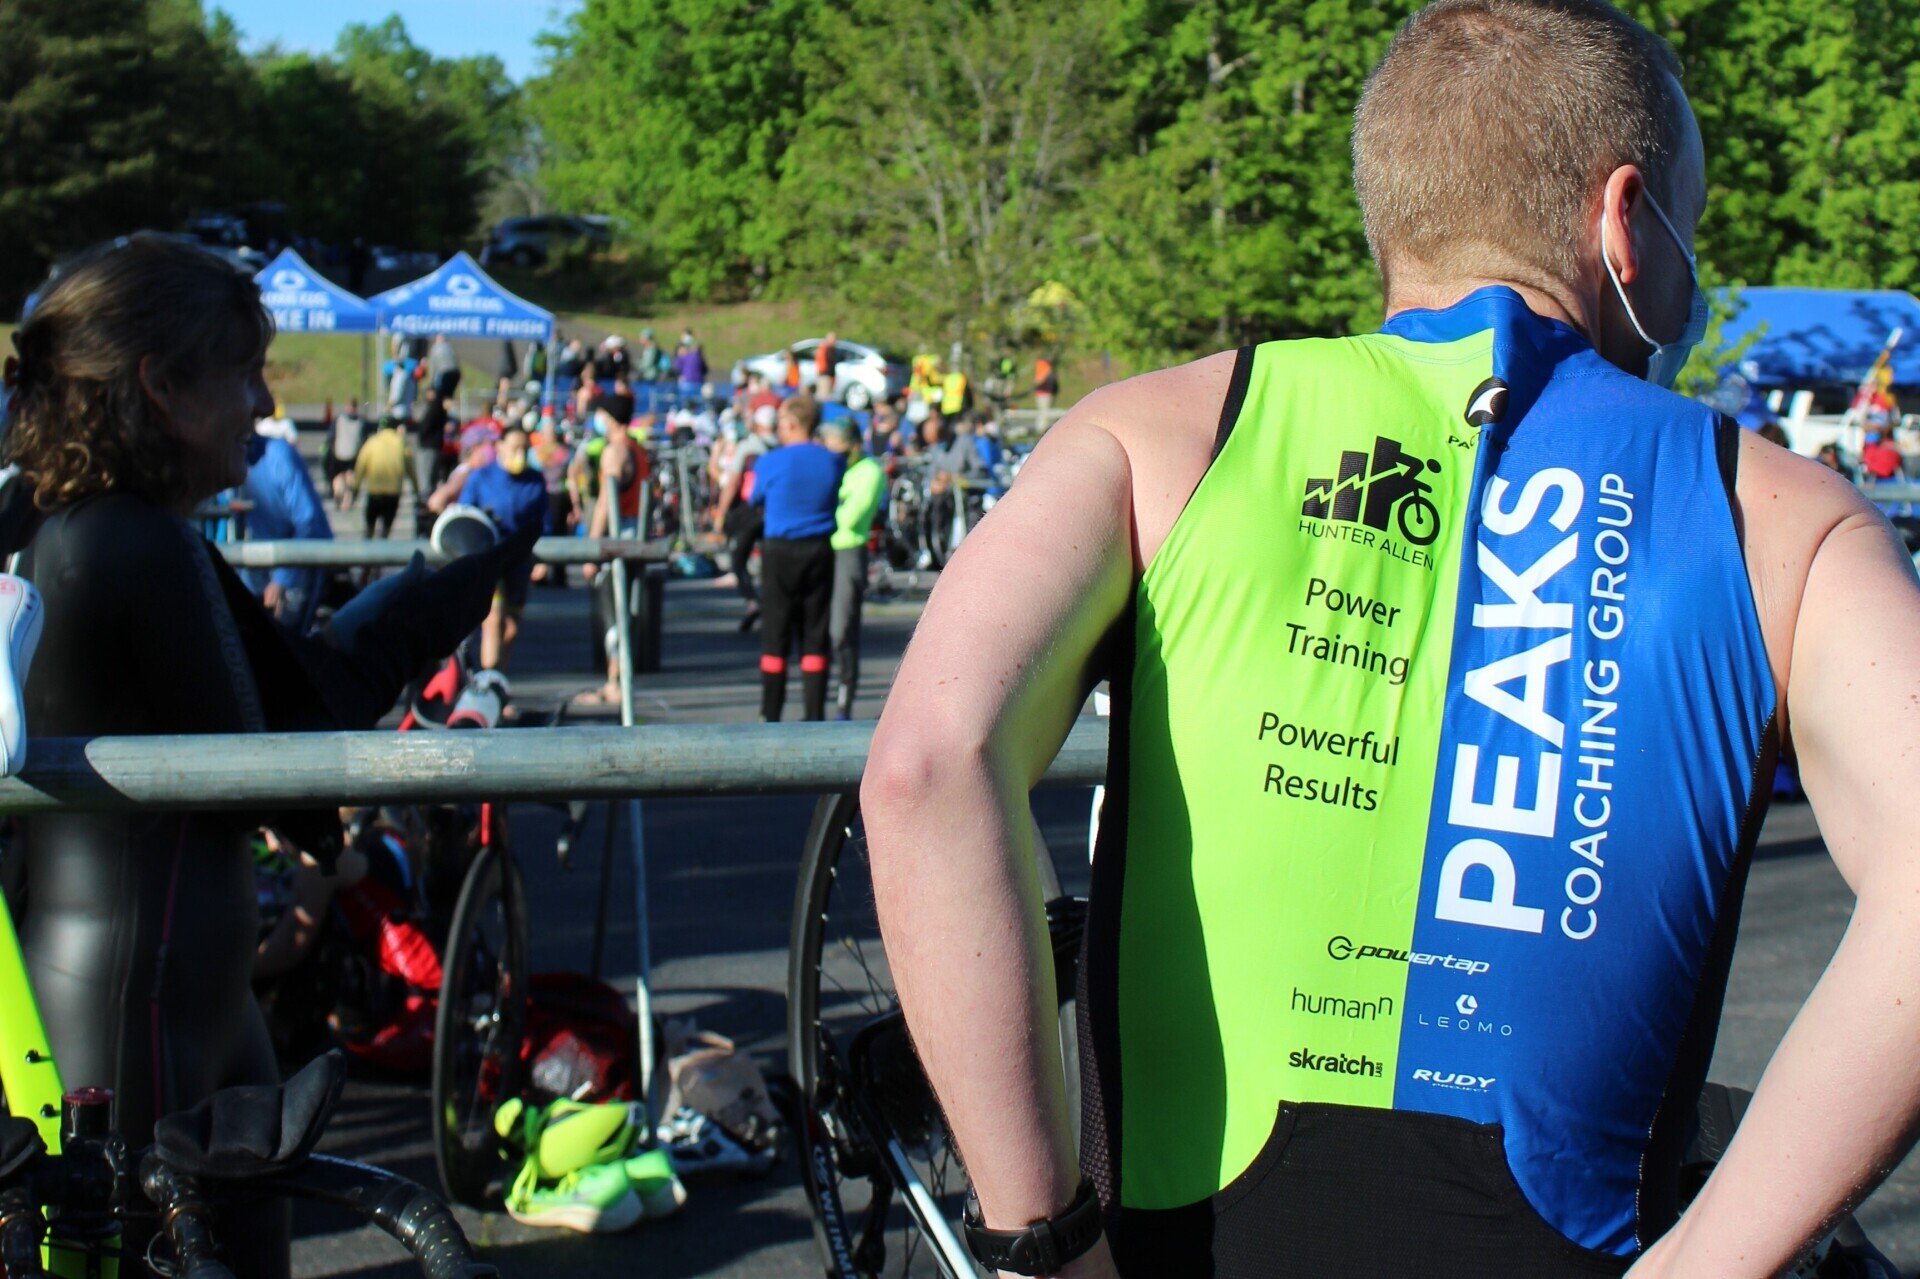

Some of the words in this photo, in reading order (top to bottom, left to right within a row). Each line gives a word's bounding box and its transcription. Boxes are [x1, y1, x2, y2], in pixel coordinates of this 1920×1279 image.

[1299, 520, 1374, 548] HUNTER
[1380, 538, 1434, 571] ALLEN
[1588, 472, 1635, 641] GROUP
[1305, 577, 1401, 628] Power
[1286, 622, 1410, 686] Training
[1434, 467, 1584, 934] PEAKS
[1258, 711, 1400, 766] Powerful
[1263, 763, 1378, 812] Results
[1560, 659, 1620, 940] COACHING
[1355, 945, 1490, 975] powertap
[1291, 987, 1393, 1021] humann
[1418, 1013, 1513, 1036] LEOMO
[1288, 1047, 1375, 1077] skratch
[1412, 1067, 1496, 1088] RUDY
